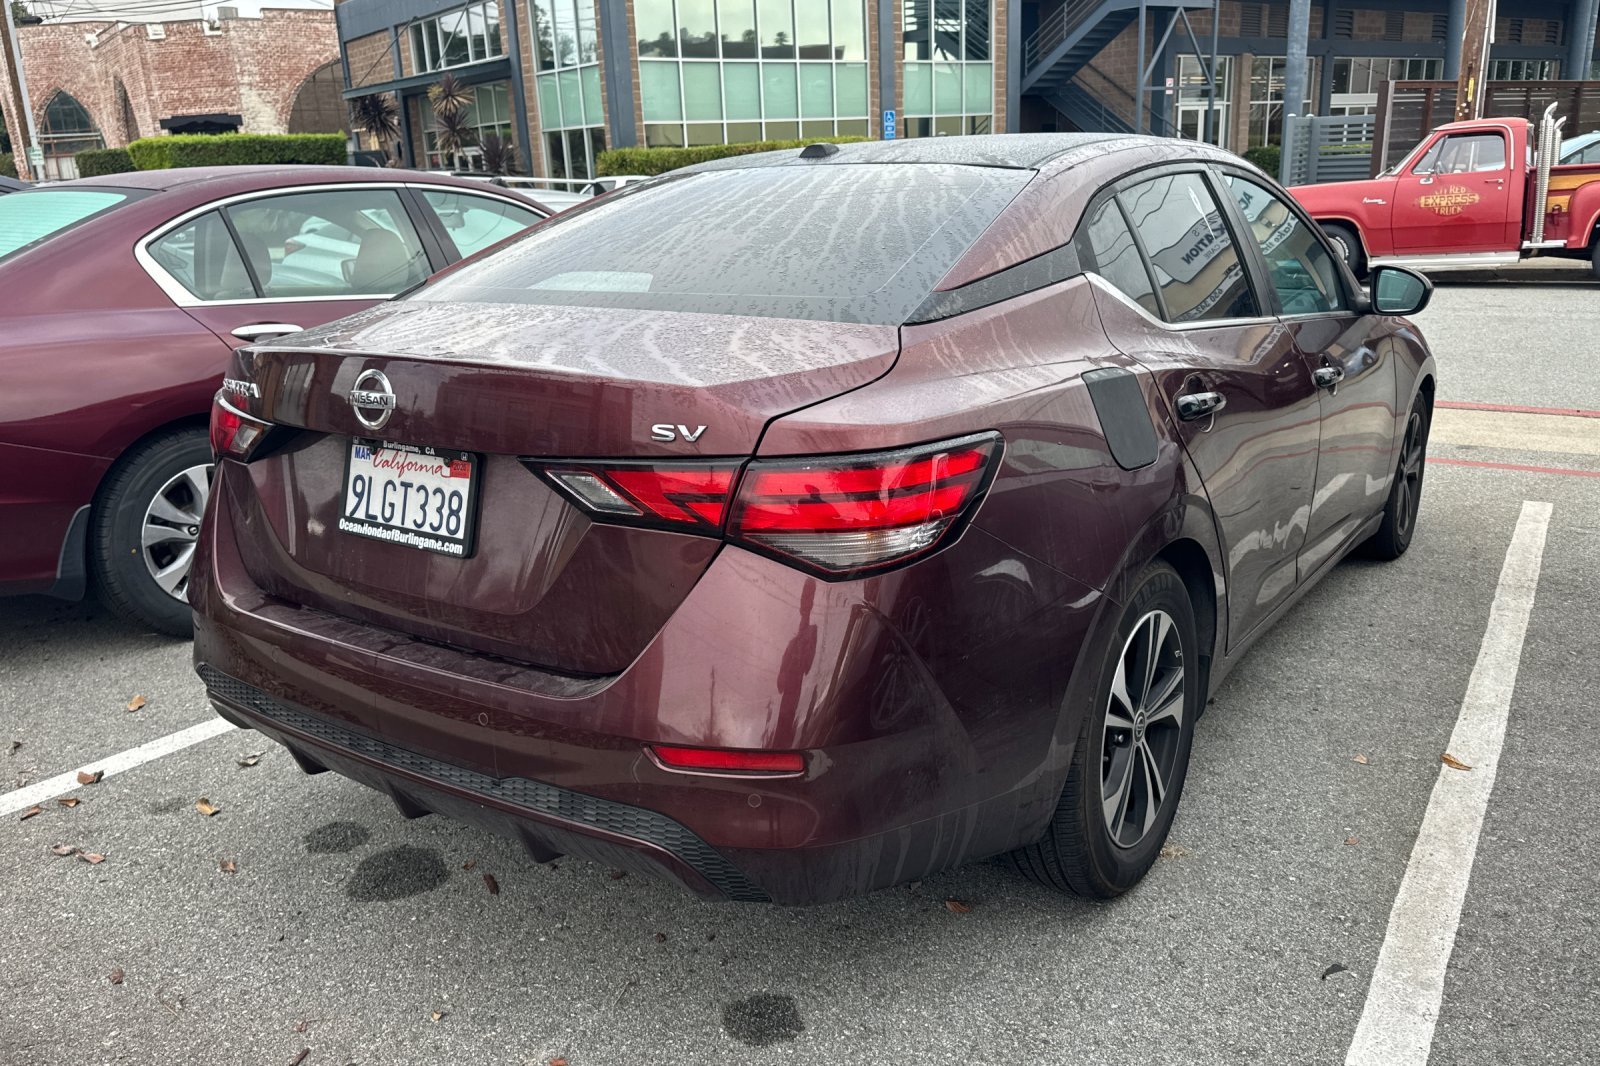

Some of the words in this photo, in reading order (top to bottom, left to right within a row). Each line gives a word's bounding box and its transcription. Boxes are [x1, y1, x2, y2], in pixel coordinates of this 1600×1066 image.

[1423, 193, 1477, 208] EXPRESS
[1434, 206, 1463, 216] TRUCK
[352, 394, 389, 406] NISSAN
[651, 423, 708, 442] SV
[354, 446, 371, 460] MAR
[383, 440, 421, 455] Burlingame,
[425, 446, 436, 456] CA
[372, 448, 451, 479] California
[349, 474, 464, 536] 9LGT338
[339, 518, 463, 554] OceanHondaofBurlingame.com
